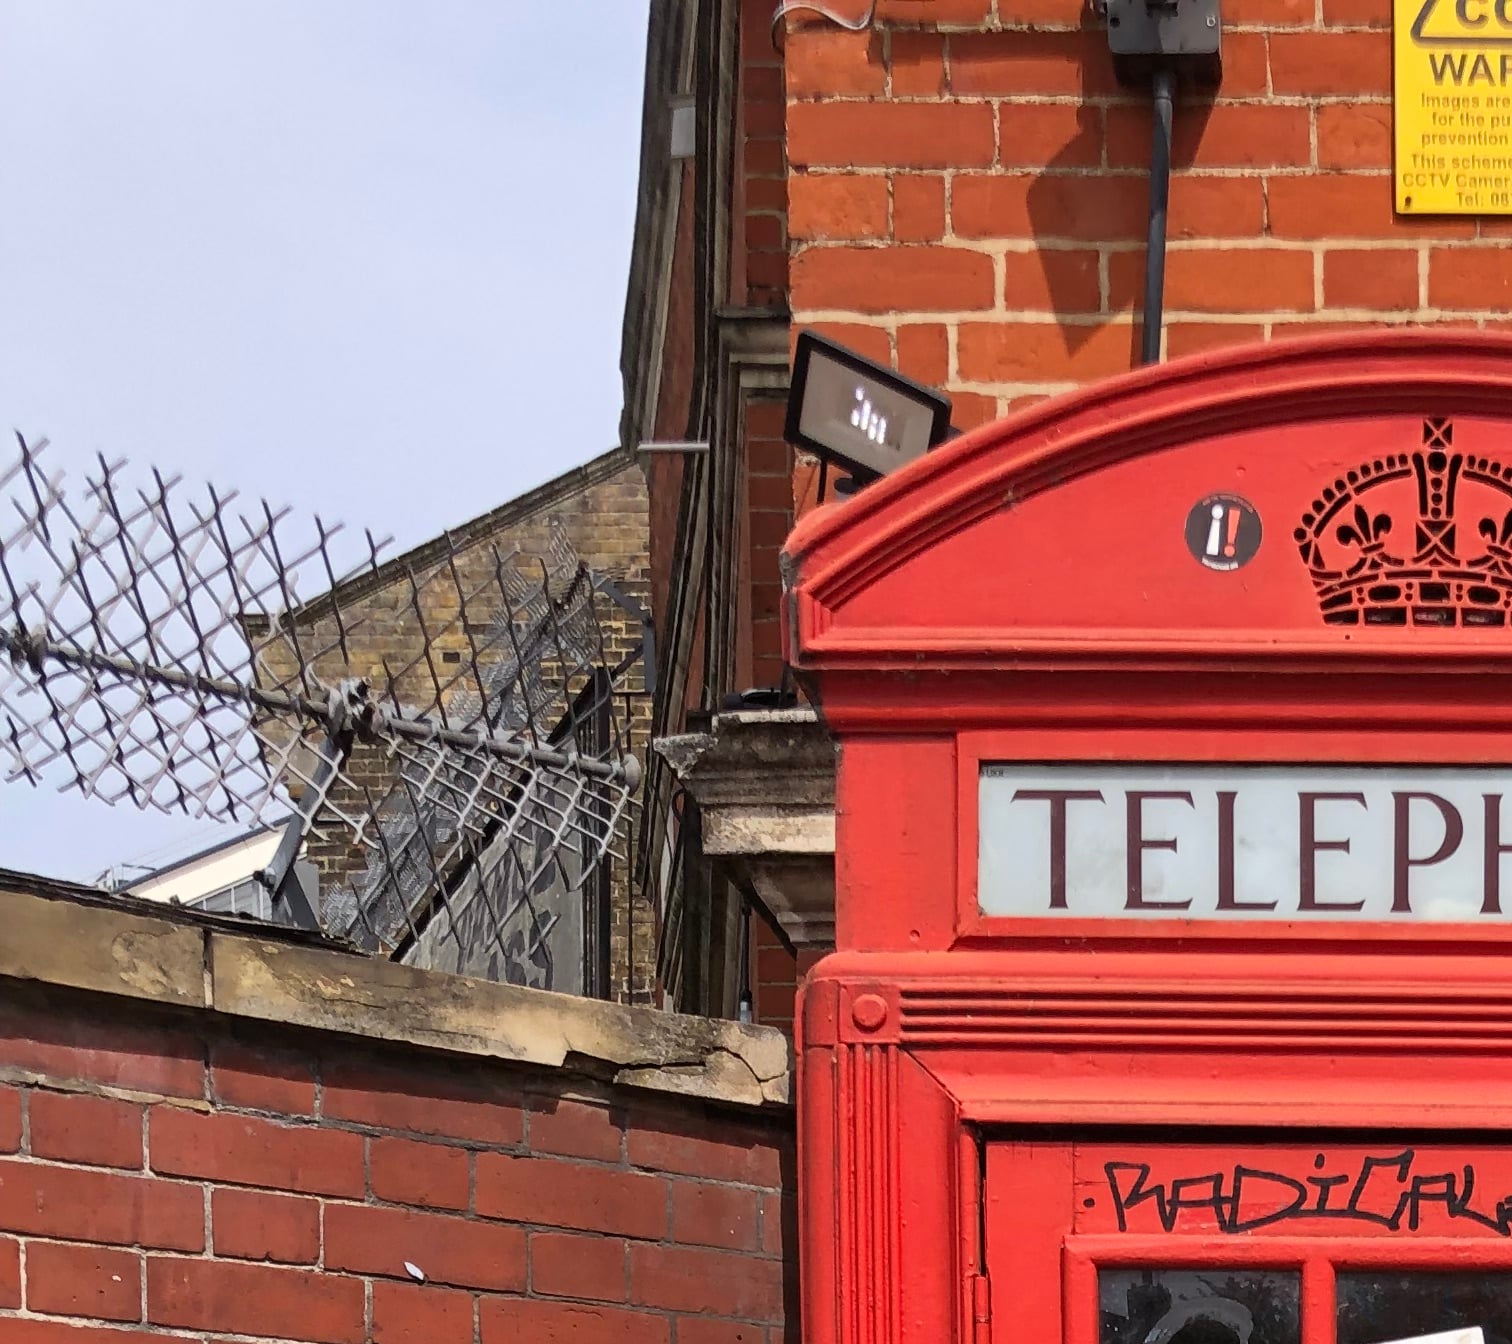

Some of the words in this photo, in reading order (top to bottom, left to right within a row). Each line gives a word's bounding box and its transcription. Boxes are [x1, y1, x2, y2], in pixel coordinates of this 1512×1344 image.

[1421, 93, 1479, 110] Images
[1486, 96, 1511, 108] are
[1433, 113, 1455, 126] for
[1460, 113, 1485, 126] the
[1421, 132, 1508, 147] prevention
[1411, 155, 1446, 169] This
[1402, 174, 1450, 187] CCTV
[1456, 192, 1483, 207] Tel:
